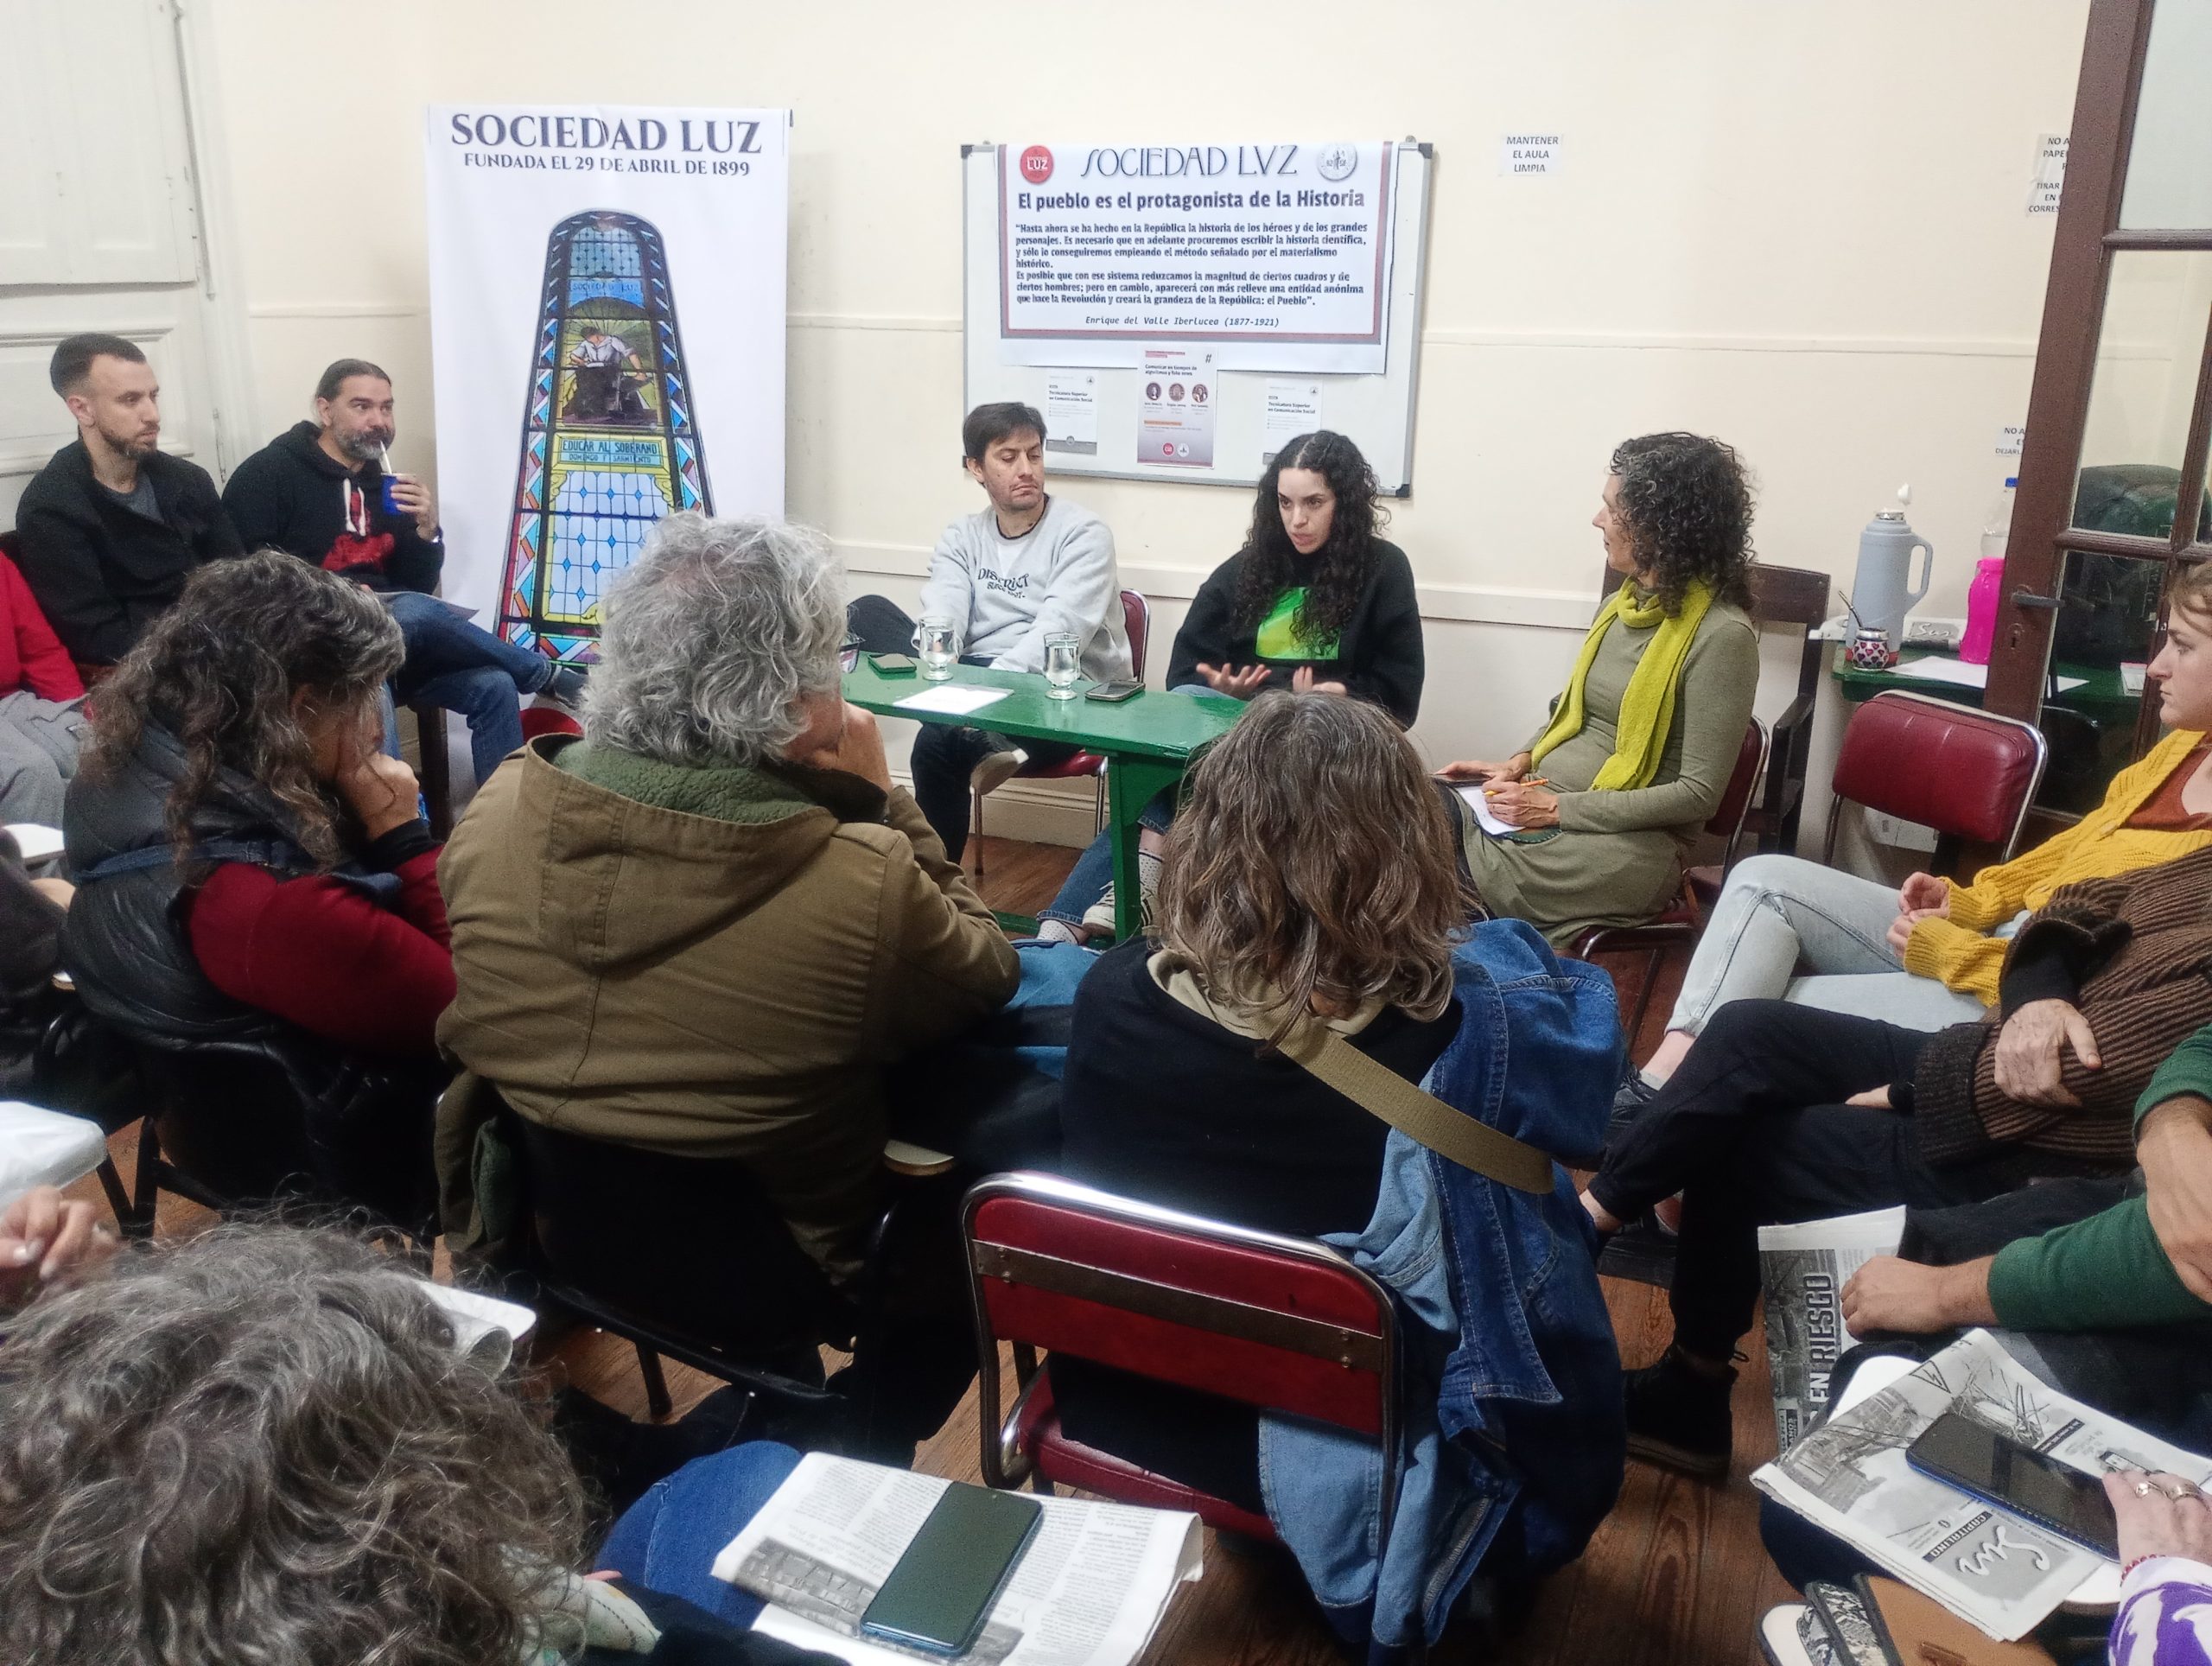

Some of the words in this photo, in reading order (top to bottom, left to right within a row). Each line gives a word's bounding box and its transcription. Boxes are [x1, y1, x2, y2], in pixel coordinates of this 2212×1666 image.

[451, 114, 668, 151] SOCIEDAD
[681, 119, 762, 153] LUZ
[1507, 136, 1558, 145] MANTENER
[1513, 150, 1522, 158] EL
[1525, 150, 1549, 158] AULA
[464, 153, 547, 169] FUNDADA
[552, 155, 571, 170] EL
[575, 156, 595, 171] 29
[600, 158, 623, 172] DE
[627, 159, 680, 174] ABRIL
[686, 160, 707, 174] DE
[712, 162, 750, 176] 1899
[1081, 147, 1227, 177] SOCIEDAD
[1514, 164, 1546, 172] LIMPIA
[1018, 193, 1031, 209] El
[1036, 192, 1090, 212] pueblo
[1095, 195, 1112, 208] es
[1117, 192, 1131, 208] el
[1137, 189, 1243, 212] protagonista
[1250, 191, 1271, 207] de
[1277, 191, 1291, 207] la
[1297, 189, 1364, 207] Historia
[1045, 224, 1068, 233] ahora
[1082, 224, 1092, 233] ha
[1094, 224, 1119, 233] hecho
[1134, 224, 1142, 233] la
[1144, 223, 1186, 234] República
[1188, 223, 1196, 233] la
[1199, 223, 1232, 233] historia
[1234, 223, 1246, 232] de
[1248, 223, 1260, 232] los
[1263, 223, 1292, 233] héroes
[1295, 225, 1301, 234] y
[1303, 223, 1314, 232] de
[1316, 223, 1328, 232] los
[1330, 223, 1367, 234] grandes
[1016, 236, 1062, 246] personajes.
[1065, 236, 1073, 245] Es
[1075, 236, 1114, 245] necesario
[1116, 237, 1132, 247] que
[1147, 236, 1185, 245] adelante
[1187, 237, 1238, 247] procuremos
[1241, 235, 1273, 245] escribir
[1275, 235, 1284, 245] la
[1286, 235, 1319, 245] historia
[1016, 249, 1021, 258] y
[1023, 247, 1039, 257] sólo
[1041, 247, 1049, 257] lo
[1051, 247, 1112, 258] conseguiremos
[1114, 247, 1161, 258] empleando
[1164, 247, 1172, 257] el
[1174, 247, 1208, 257] método
[1210, 247, 1249, 257] señalado
[1252, 249, 1267, 258] por
[1270, 247, 1278, 257] el
[1280, 247, 1337, 257] materialismo
[1016, 259, 1054, 269] histórico.
[1017, 271, 1025, 280] Es
[1026, 271, 1055, 281] posible
[1057, 272, 1073, 282] que
[1107, 271, 1139, 280] sistema
[1142, 271, 1192, 280] reduzcamos
[1194, 272, 1202, 280] la
[1205, 271, 1247, 282] magnitud
[1249, 271, 1260, 280] de
[1263, 272, 1291, 281] ciertos
[1294, 271, 1328, 281] cuadros
[1329, 274, 1335, 283] y
[1338, 271, 1350, 281] de
[1017, 283, 1043, 292] ciertos
[1045, 283, 1084, 293] hombres;
[1086, 285, 1105, 294] pero
[1120, 283, 1153, 293] cambio,
[1155, 283, 1197, 293] aparecerá
[1200, 285, 1214, 293] con
[1217, 283, 1234, 293] más
[1237, 283, 1268, 293] relieve
[1288, 283, 1321, 293] entidad
[1323, 284, 1364, 293] anónima
[1017, 296, 1030, 305] que
[1032, 294, 1050, 303] hace
[1052, 294, 1059, 303] la
[1061, 294, 1106, 304] Revolución
[1108, 297, 1113, 305] y
[1116, 295, 1142, 304] creará
[1144, 295, 1151, 304] la
[1154, 295, 1193, 305] grandeza
[1195, 296, 1207, 305] de
[1208, 296, 1217, 305] la
[1267, 295, 1275, 305] el
[1085, 316, 1120, 326] Enrique
[1124, 316, 1138, 325] del
[1144, 317, 1169, 325] Valle
[1174, 316, 1219, 326] Iberlucea
[1224, 317, 1280, 327] (1877-1921)
[563, 439, 594, 451] EDUCAR
[599, 441, 610, 452] AL
[615, 442, 657, 454] SOBERANO
[1802, 1275, 1834, 1364] RIESGO
